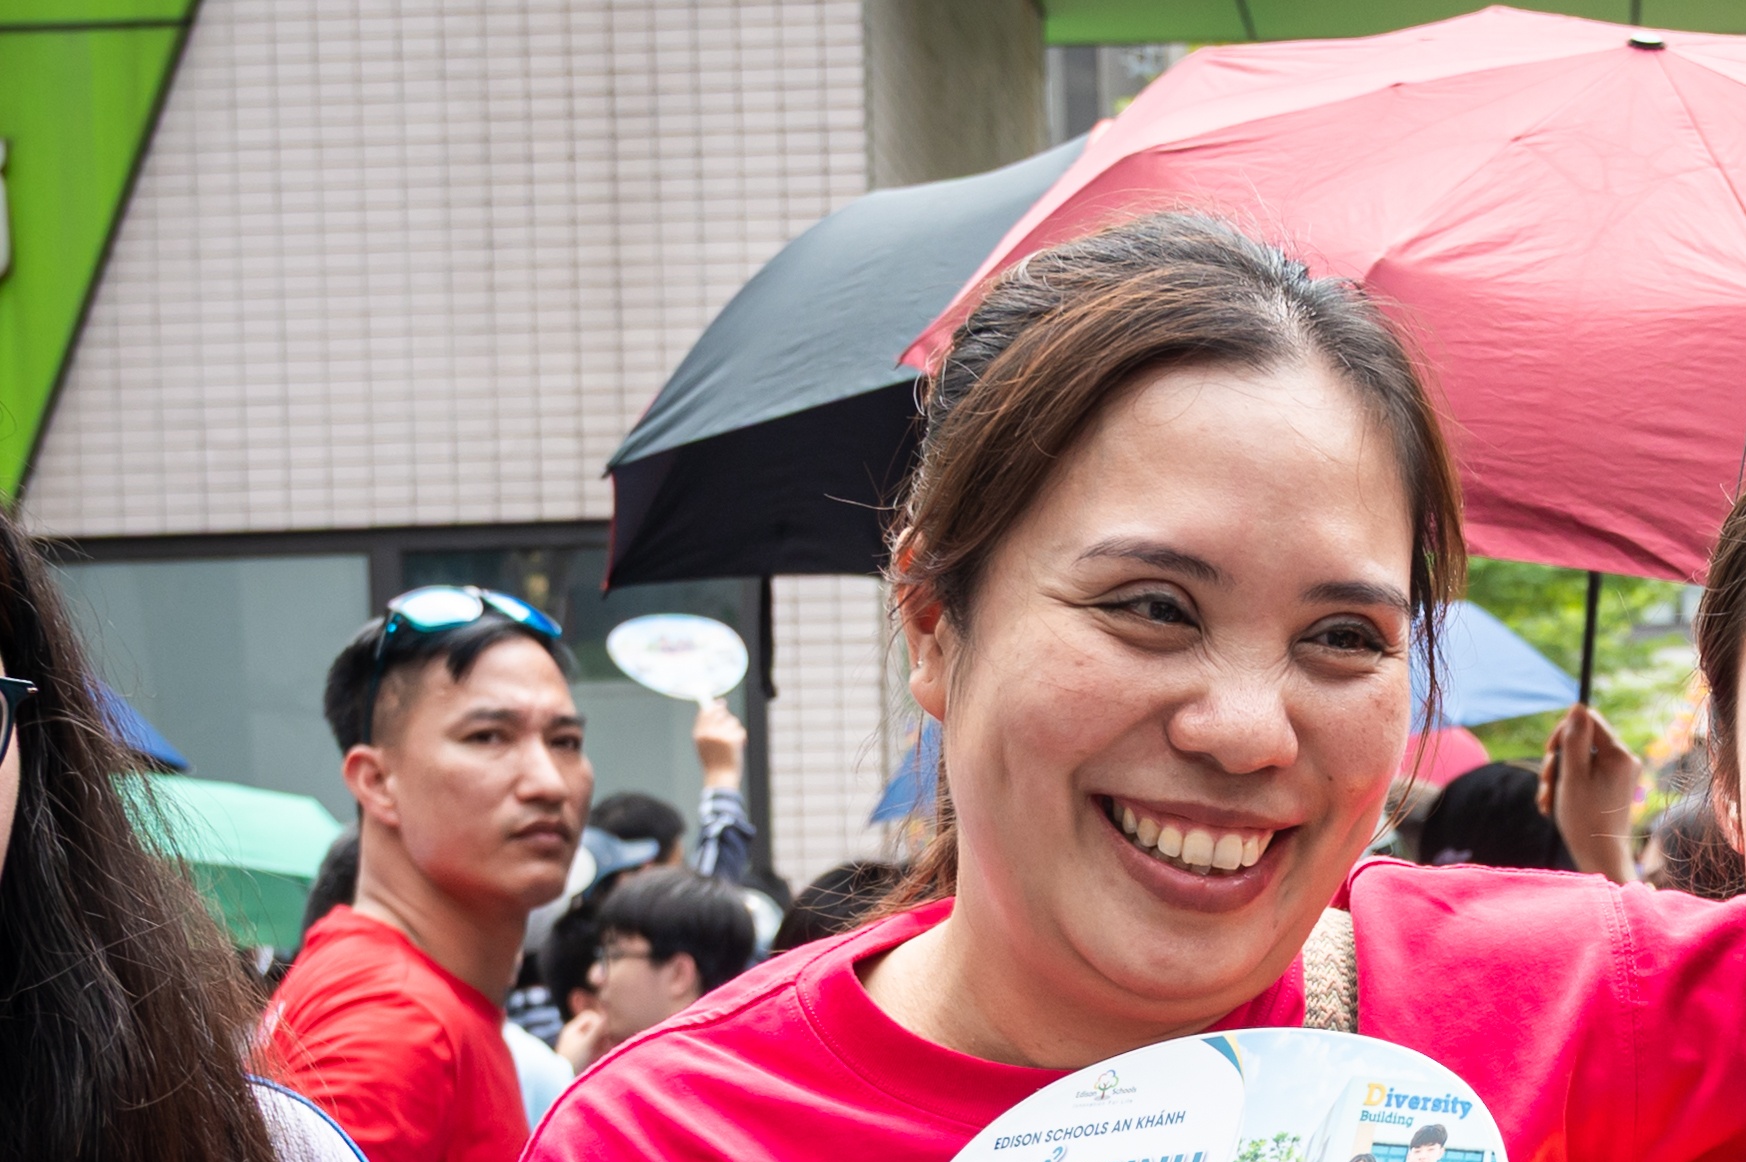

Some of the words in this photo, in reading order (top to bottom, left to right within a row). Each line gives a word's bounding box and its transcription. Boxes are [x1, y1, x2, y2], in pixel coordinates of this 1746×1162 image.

[1360, 1110, 1414, 1128] Building
[1363, 1082, 1473, 1120] Diversity
[994, 1131, 1042, 1150] EDISON
[1044, 1122, 1109, 1143] SCHOOLS
[1111, 1118, 1133, 1133] AN
[1135, 1110, 1186, 1130] KHÁNH
